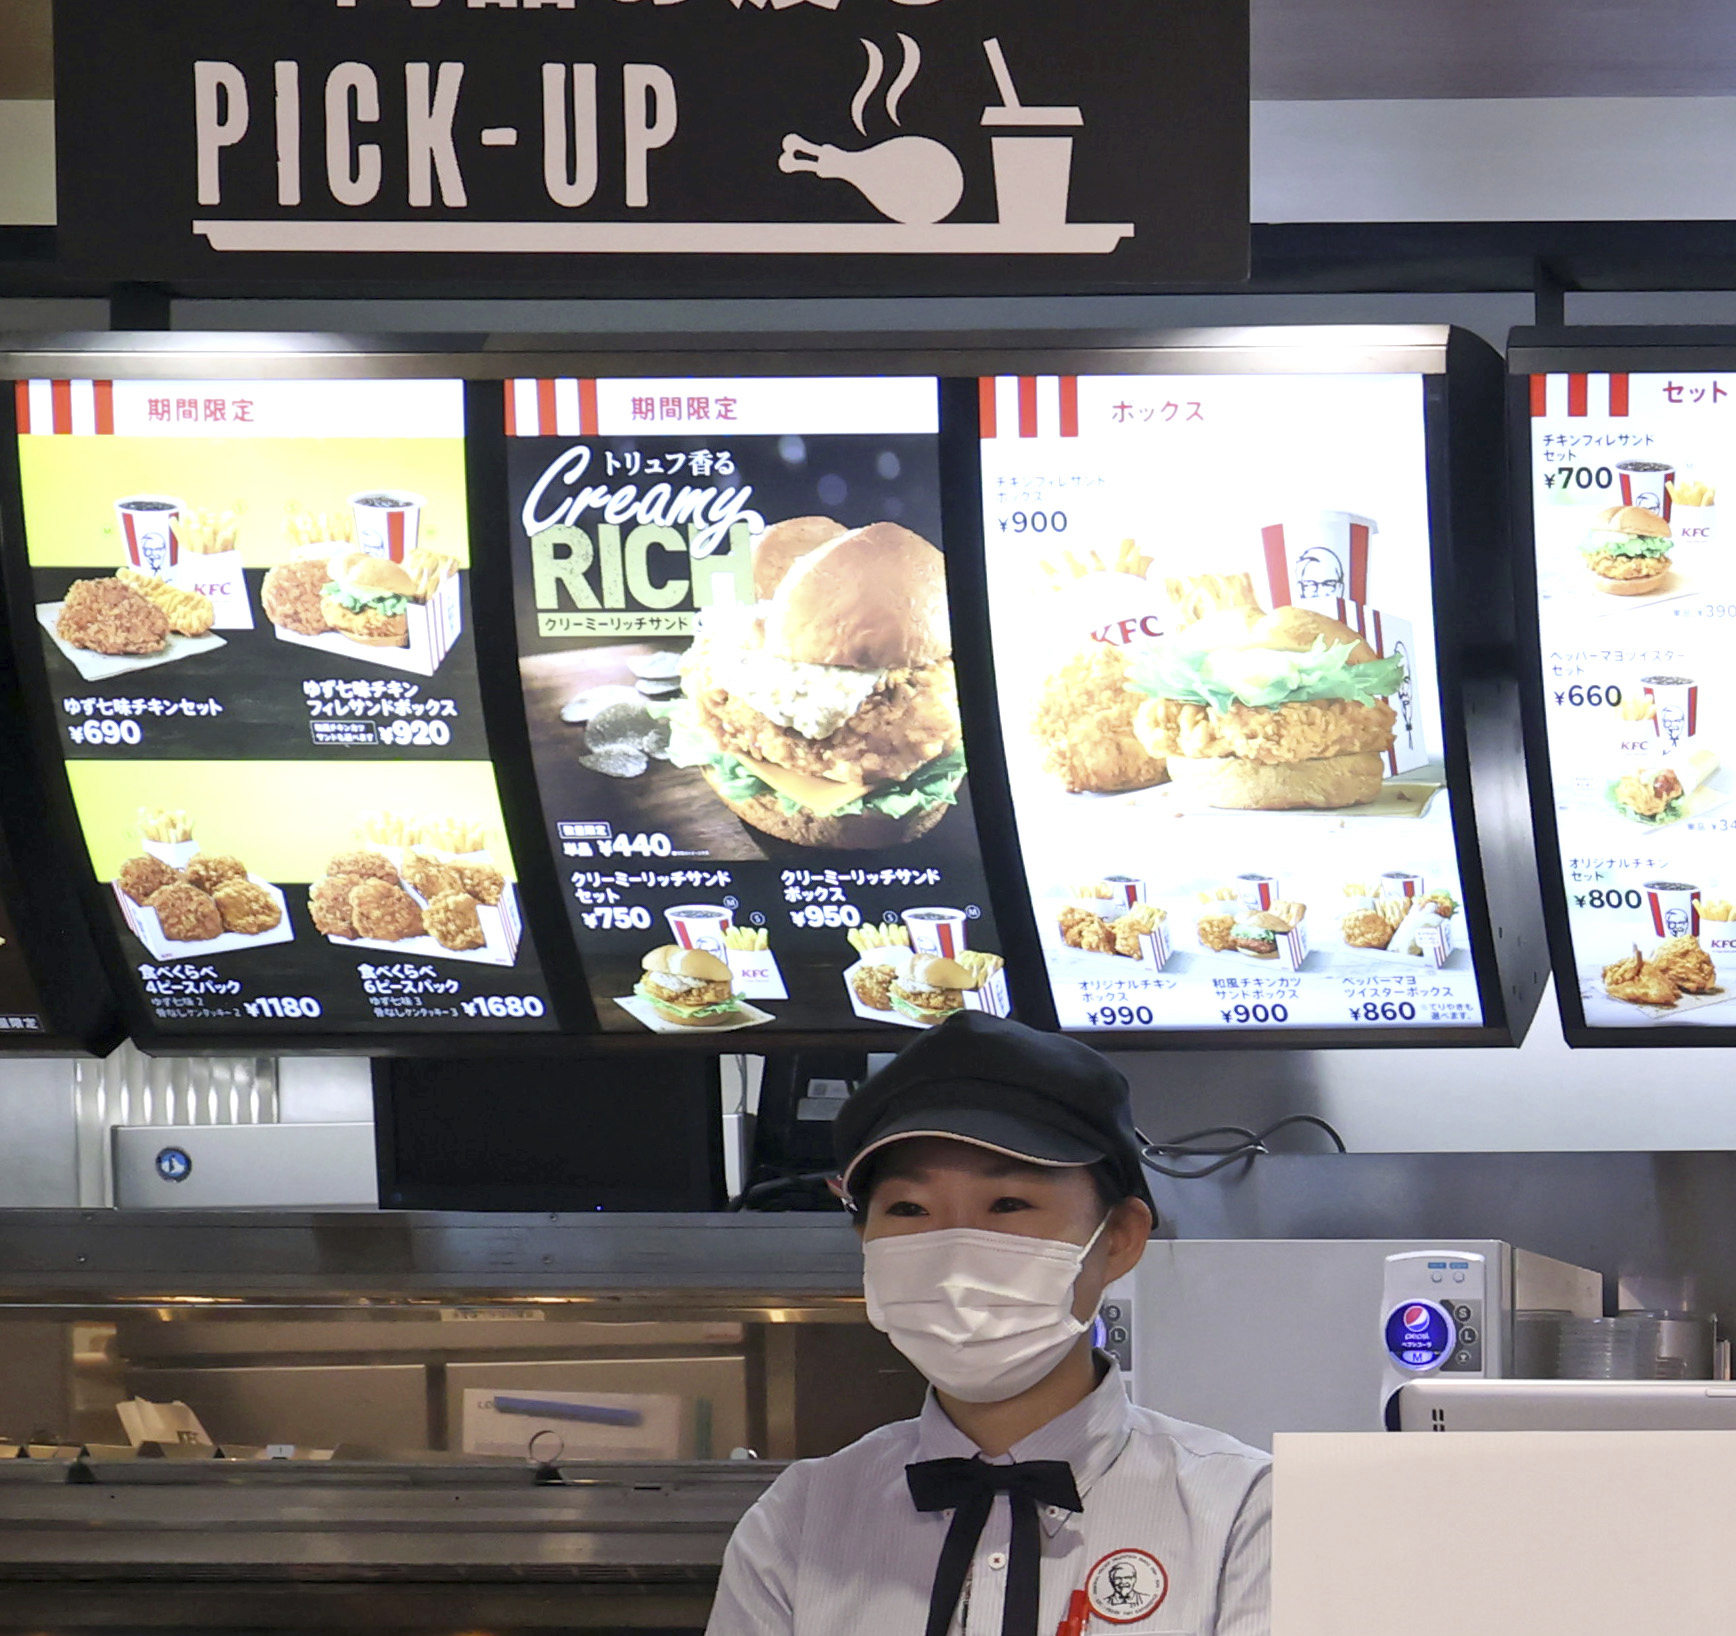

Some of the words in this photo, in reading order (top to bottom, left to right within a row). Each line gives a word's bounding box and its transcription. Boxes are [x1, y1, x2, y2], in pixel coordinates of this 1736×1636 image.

[194, 60, 679, 208] PICK-UP
[1662, 379, 1728, 404] セット
[148, 398, 256, 423] 期間限定
[632, 396, 738, 421] 期間限定
[1111, 400, 1204, 423] ボックス
[1542, 433, 1656, 447] チキンフィレサンド
[605, 449, 736, 476] トリュフ香る
[1543, 449, 1578, 462] セット
[1543, 465, 1614, 490] ¥700
[522, 445, 766, 560] Creamy
[998, 510, 1068, 533] ¥900
[1681, 526, 1711, 539] KFC
[531, 523, 754, 610] RICH
[544, 616, 690, 632] クリーミーリッチサンド
[1090, 614, 1164, 647] KFC
[303, 680, 420, 698] ゆず七味チキン
[1554, 683, 1623, 708] ¥660
[63, 697, 224, 717] ゆず七味チキンセット
[306, 698, 458, 717] フィレサンドボックス
[69, 718, 144, 745] ¥690
[379, 718, 452, 746] ¥920
[1620, 740, 1649, 752] KFC
[596, 832, 671, 857] ¥440
[1569, 856, 1669, 870] オリジナルチキン
[570, 869, 733, 888] クリーミーリッチサンド
[780, 867, 942, 887] クリーミーリッチサンド
[1571, 870, 1605, 883] セット
[574, 888, 621, 905] セット
[783, 885, 847, 903] ボックス
[1573, 888, 1643, 911] ¥800
[582, 905, 653, 930] ¥750
[790, 904, 862, 929] ¥950
[138, 963, 218, 981] 食べくらべ
[357, 963, 437, 980] 食べくらべ
[741, 967, 769, 979] KFC
[145, 980, 242, 996] 4ピースパック
[363, 978, 460, 995] 6ピースパック
[1079, 978, 1177, 991] オリジナルチキン
[1212, 976, 1302, 990] 和風チキンカツ
[243, 995, 322, 1019] ¥1180
[460, 995, 546, 1019] ¥1680
[1087, 1005, 1154, 1026] ¥990
[1220, 1003, 1289, 1025] ¥900
[1349, 1000, 1416, 1022] ¥860
[1109, 1307, 1117, 1319] S
[1458, 1308, 1468, 1320] S
[1114, 1330, 1121, 1341] L
[1464, 1330, 1472, 1341] L
[1412, 1352, 1423, 1363] M
